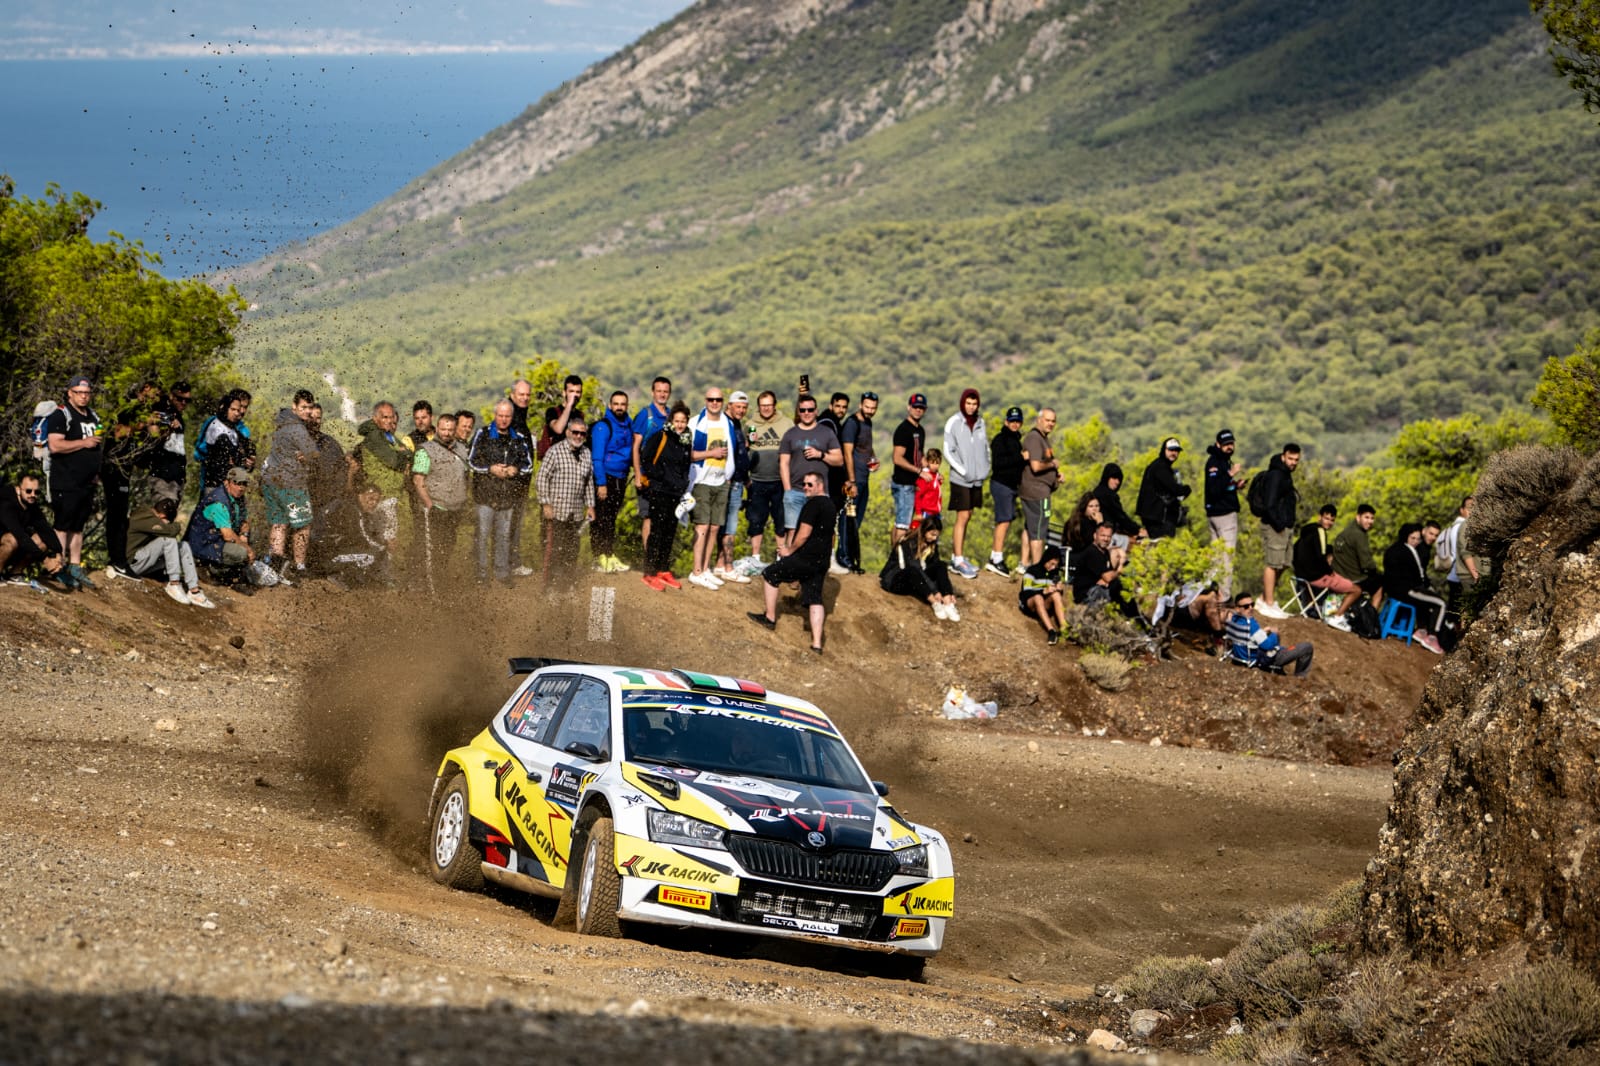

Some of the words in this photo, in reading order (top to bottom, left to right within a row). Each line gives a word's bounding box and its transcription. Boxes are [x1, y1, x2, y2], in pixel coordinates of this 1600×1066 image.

[697, 707, 737, 718] JK
[737, 713, 806, 731] RACING
[777, 808, 811, 818] JK
[812, 810, 872, 821] RACING
[505, 781, 527, 818] JK
[522, 811, 560, 868] RACING
[641, 861, 671, 876] JK
[668, 867, 721, 884] RACING
[663, 889, 707, 906] PIRELLI
[912, 896, 927, 911] JK
[926, 899, 953, 912] RACING
[762, 917, 796, 928] DELTA
[802, 923, 838, 933] RALLY
[899, 922, 924, 934] PIRELLI
